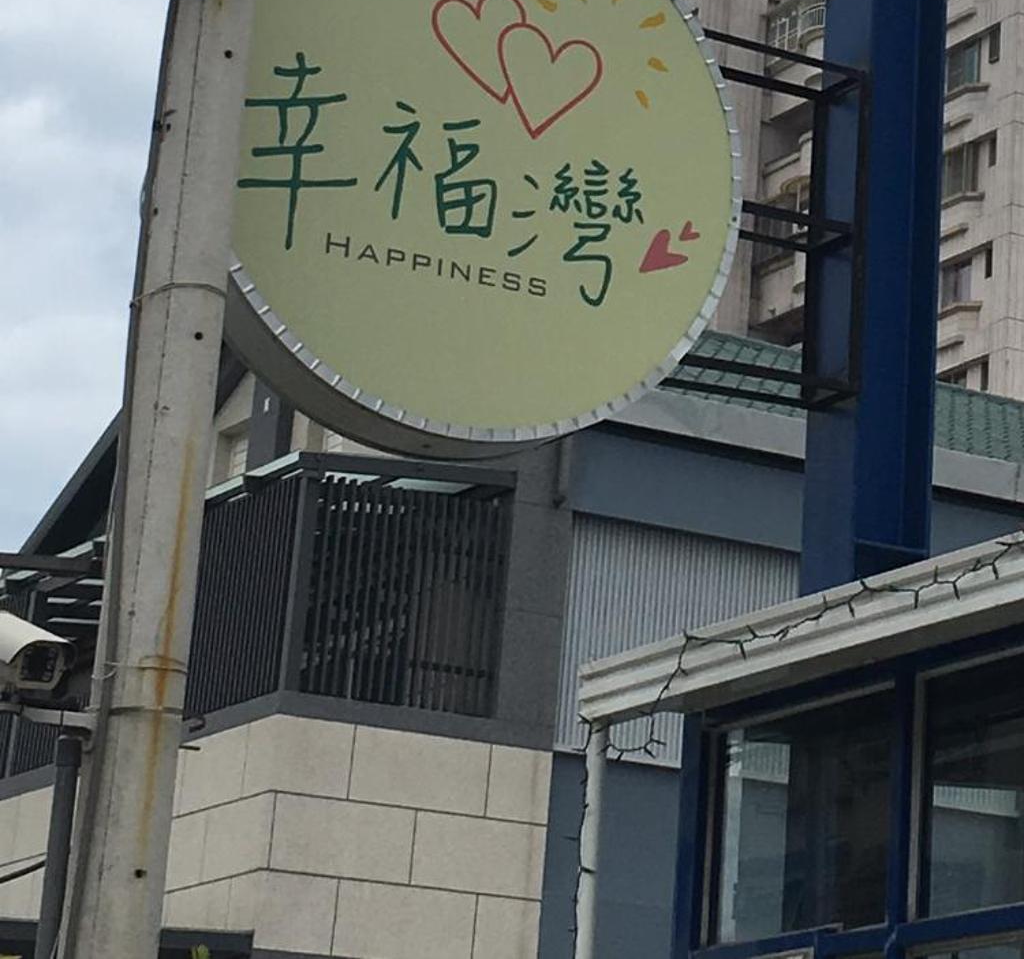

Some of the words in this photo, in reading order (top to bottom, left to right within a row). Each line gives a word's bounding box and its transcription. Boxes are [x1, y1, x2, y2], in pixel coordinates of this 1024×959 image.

[236, 51, 645, 307] 幸福灣
[325, 232, 548, 297] HAPPINESS
